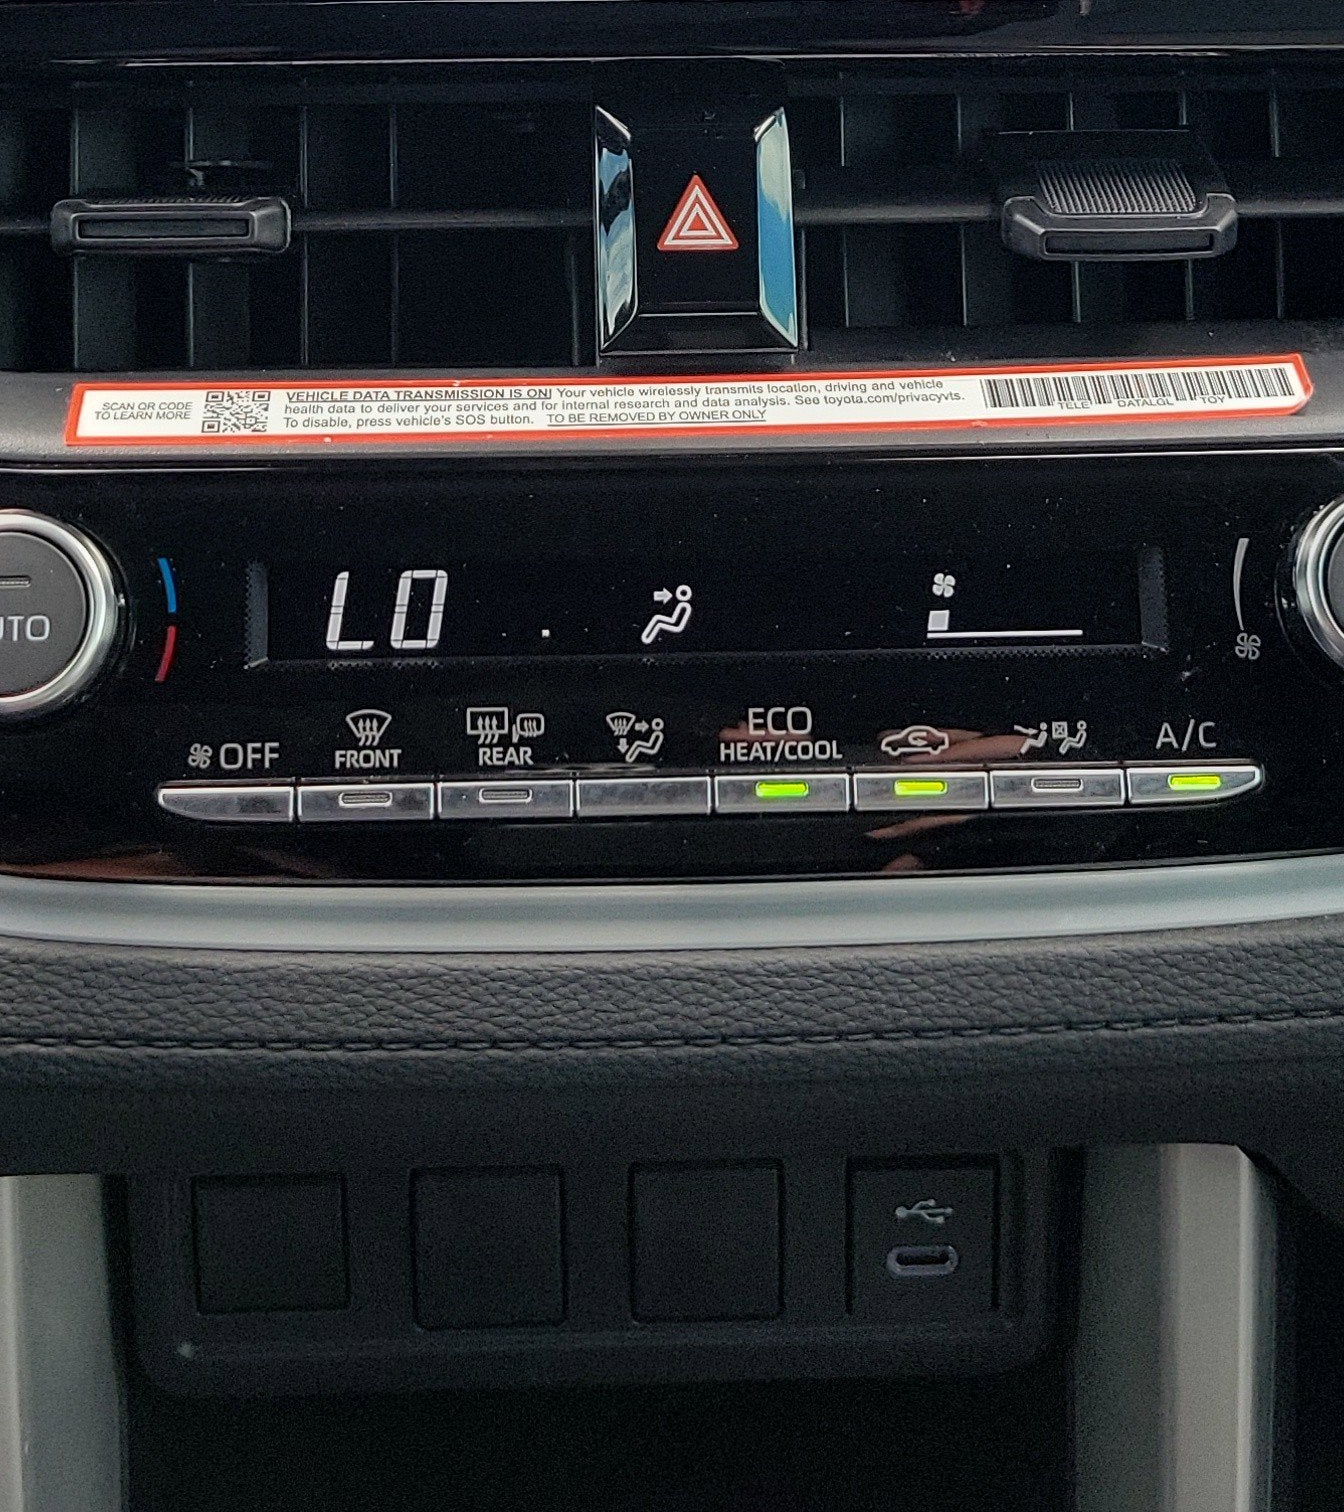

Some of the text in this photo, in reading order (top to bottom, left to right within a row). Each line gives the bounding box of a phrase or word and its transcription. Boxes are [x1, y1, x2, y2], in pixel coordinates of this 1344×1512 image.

[286, 391, 352, 402] VEHICLE
[354, 390, 390, 401] DATA
[392, 388, 505, 400] TRANSMISSION
[509, 388, 523, 399] IS
[558, 387, 586, 398] Your
[589, 385, 635, 397] vehicle
[638, 384, 701, 397] wirelessly
[705, 383, 763, 395] transmits
[767, 382, 821, 393] location,
[825, 380, 867, 393] driving
[871, 380, 895, 391] and
[899, 378, 944, 390] vehicle
[102, 401, 193, 411] SCAN QR CODE
[284, 390, 965, 415] health data to deliver your services and for internal research and data analysis. See toyota.com/privacyvts.
[95, 410, 191, 420] TO LEARN MORE
[284, 409, 767, 430] To disable, press vehicle's SOS button. TO BE REMOVED BY OWNER ONLY
[326, 569, 448, 651] LO
[748, 707, 812, 735] ECO
[1156, 723, 1217, 750] A/C
[220, 743, 280, 770] OFF
[334, 750, 402, 769] FRONT
[478, 748, 533, 767] REAR
[719, 740, 843, 763] HEAT/COOL
